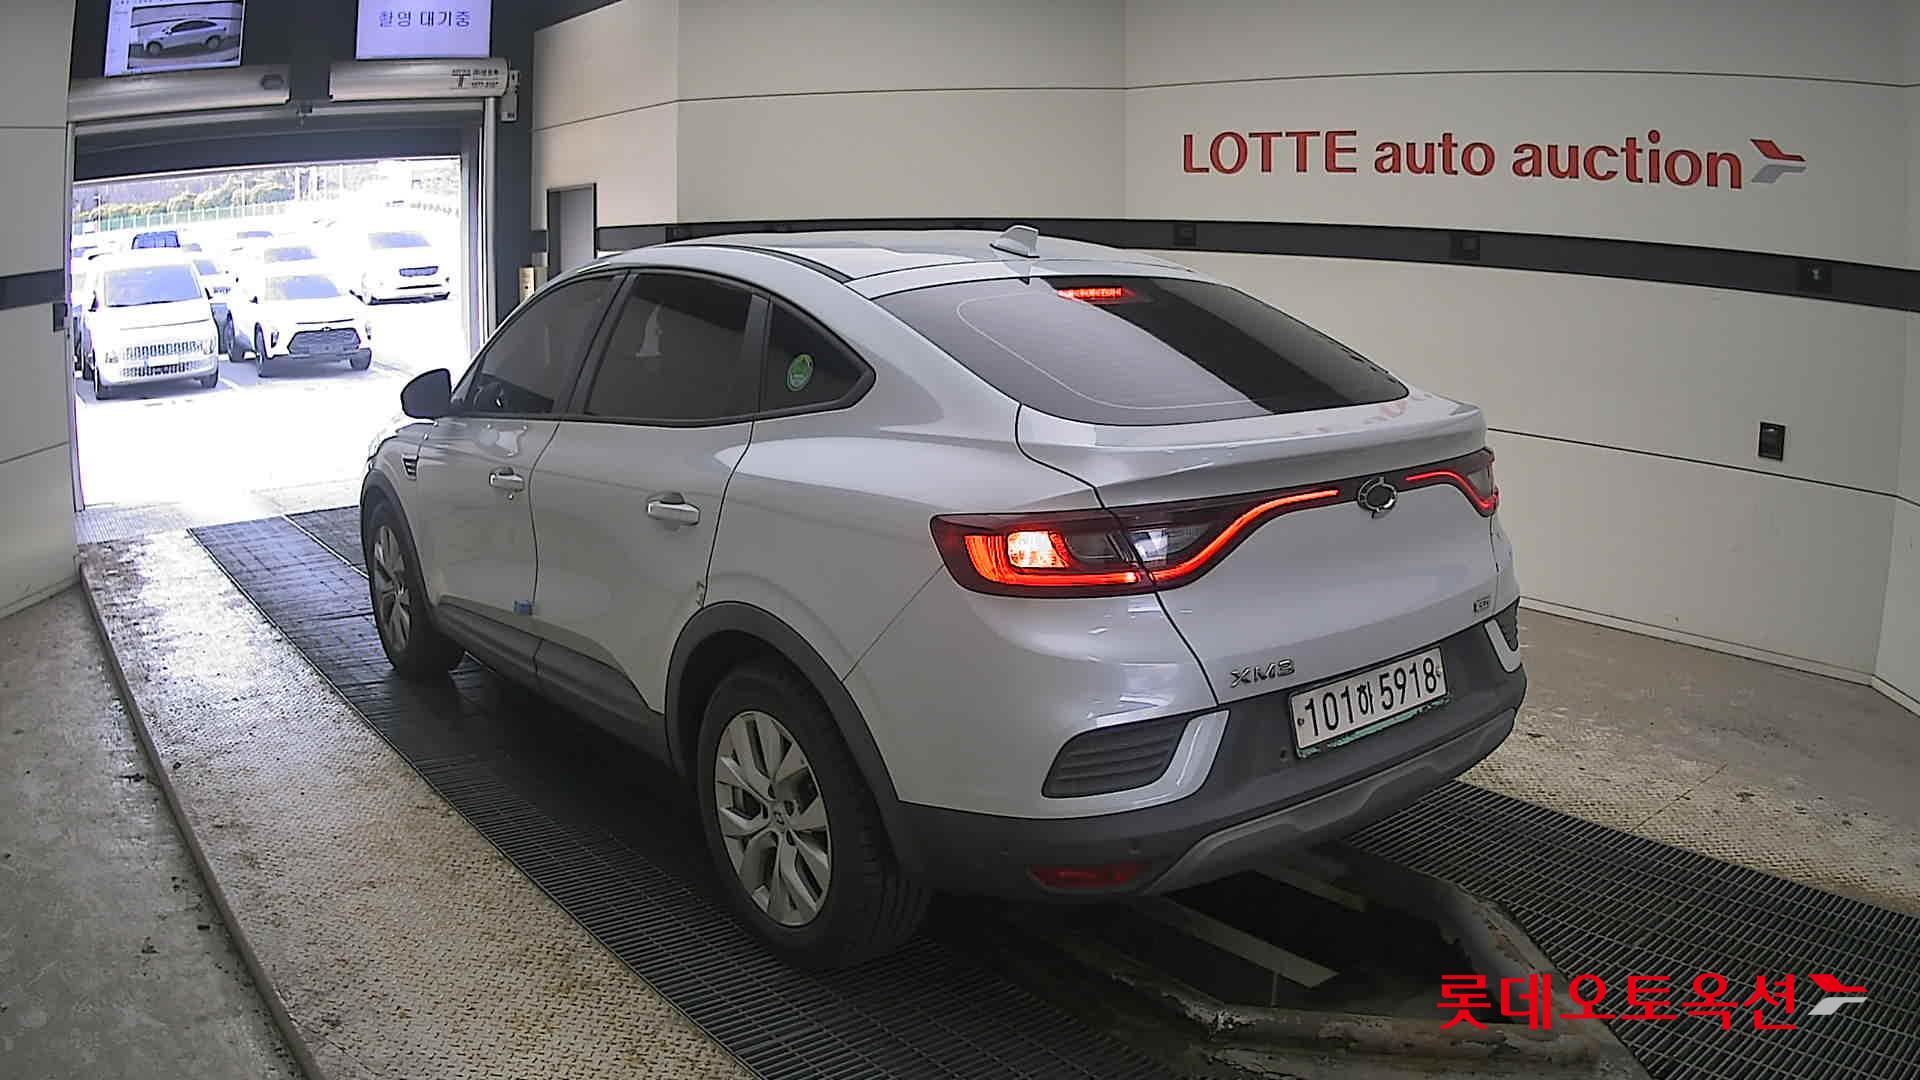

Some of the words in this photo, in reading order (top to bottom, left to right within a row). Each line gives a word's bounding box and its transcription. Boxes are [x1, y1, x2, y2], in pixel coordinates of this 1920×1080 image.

[420, 10, 471, 28] 대기중
[1183, 130, 1357, 174] LOTTE
[1374, 132, 1495, 176] auto
[1512, 130, 1742, 189] auction
[1230, 658, 1295, 688] XM3
